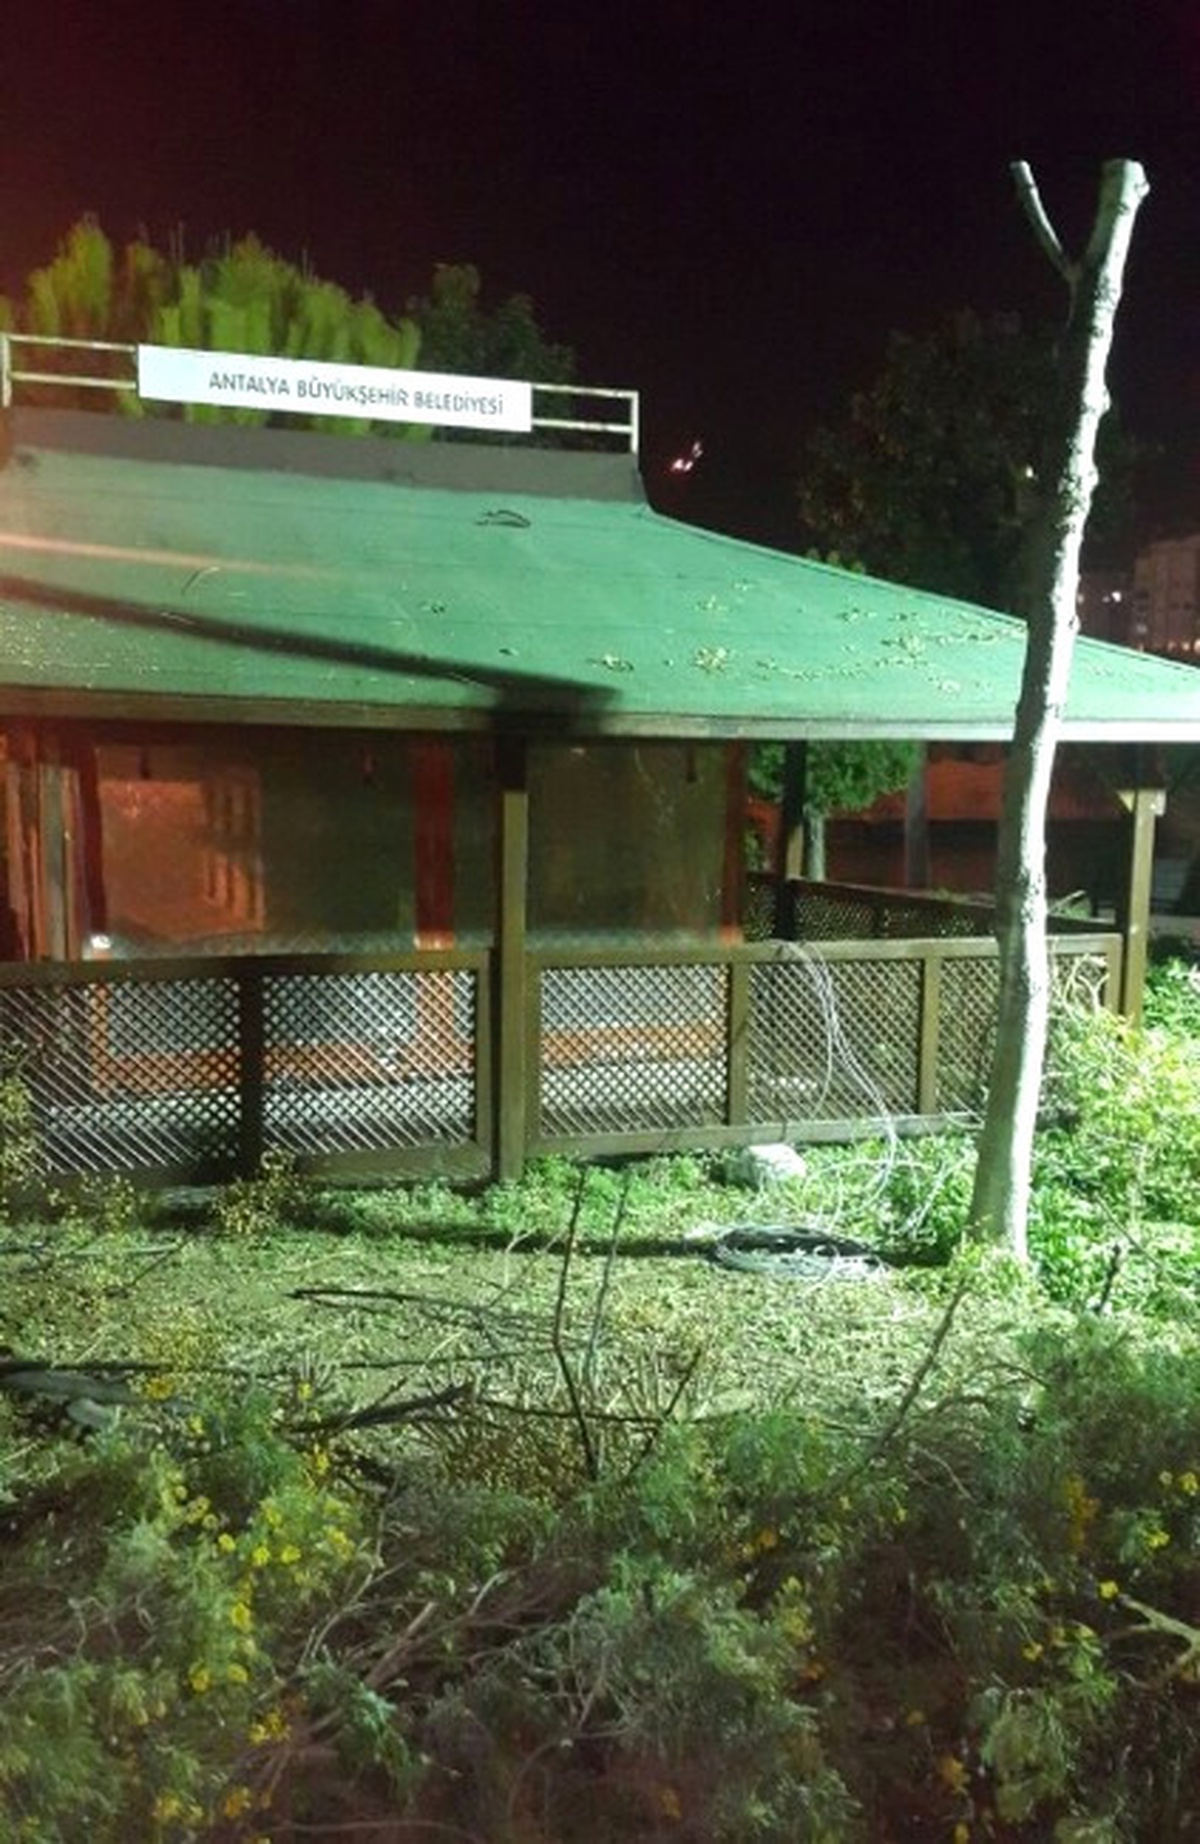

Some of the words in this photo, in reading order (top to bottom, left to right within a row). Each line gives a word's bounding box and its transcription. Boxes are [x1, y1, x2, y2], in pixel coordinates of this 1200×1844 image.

[209, 371, 290, 396] ANTALYA
[297, 376, 409, 406] BÜYÜKŞEHİR
[414, 390, 503, 415] BELEDİYESİ
